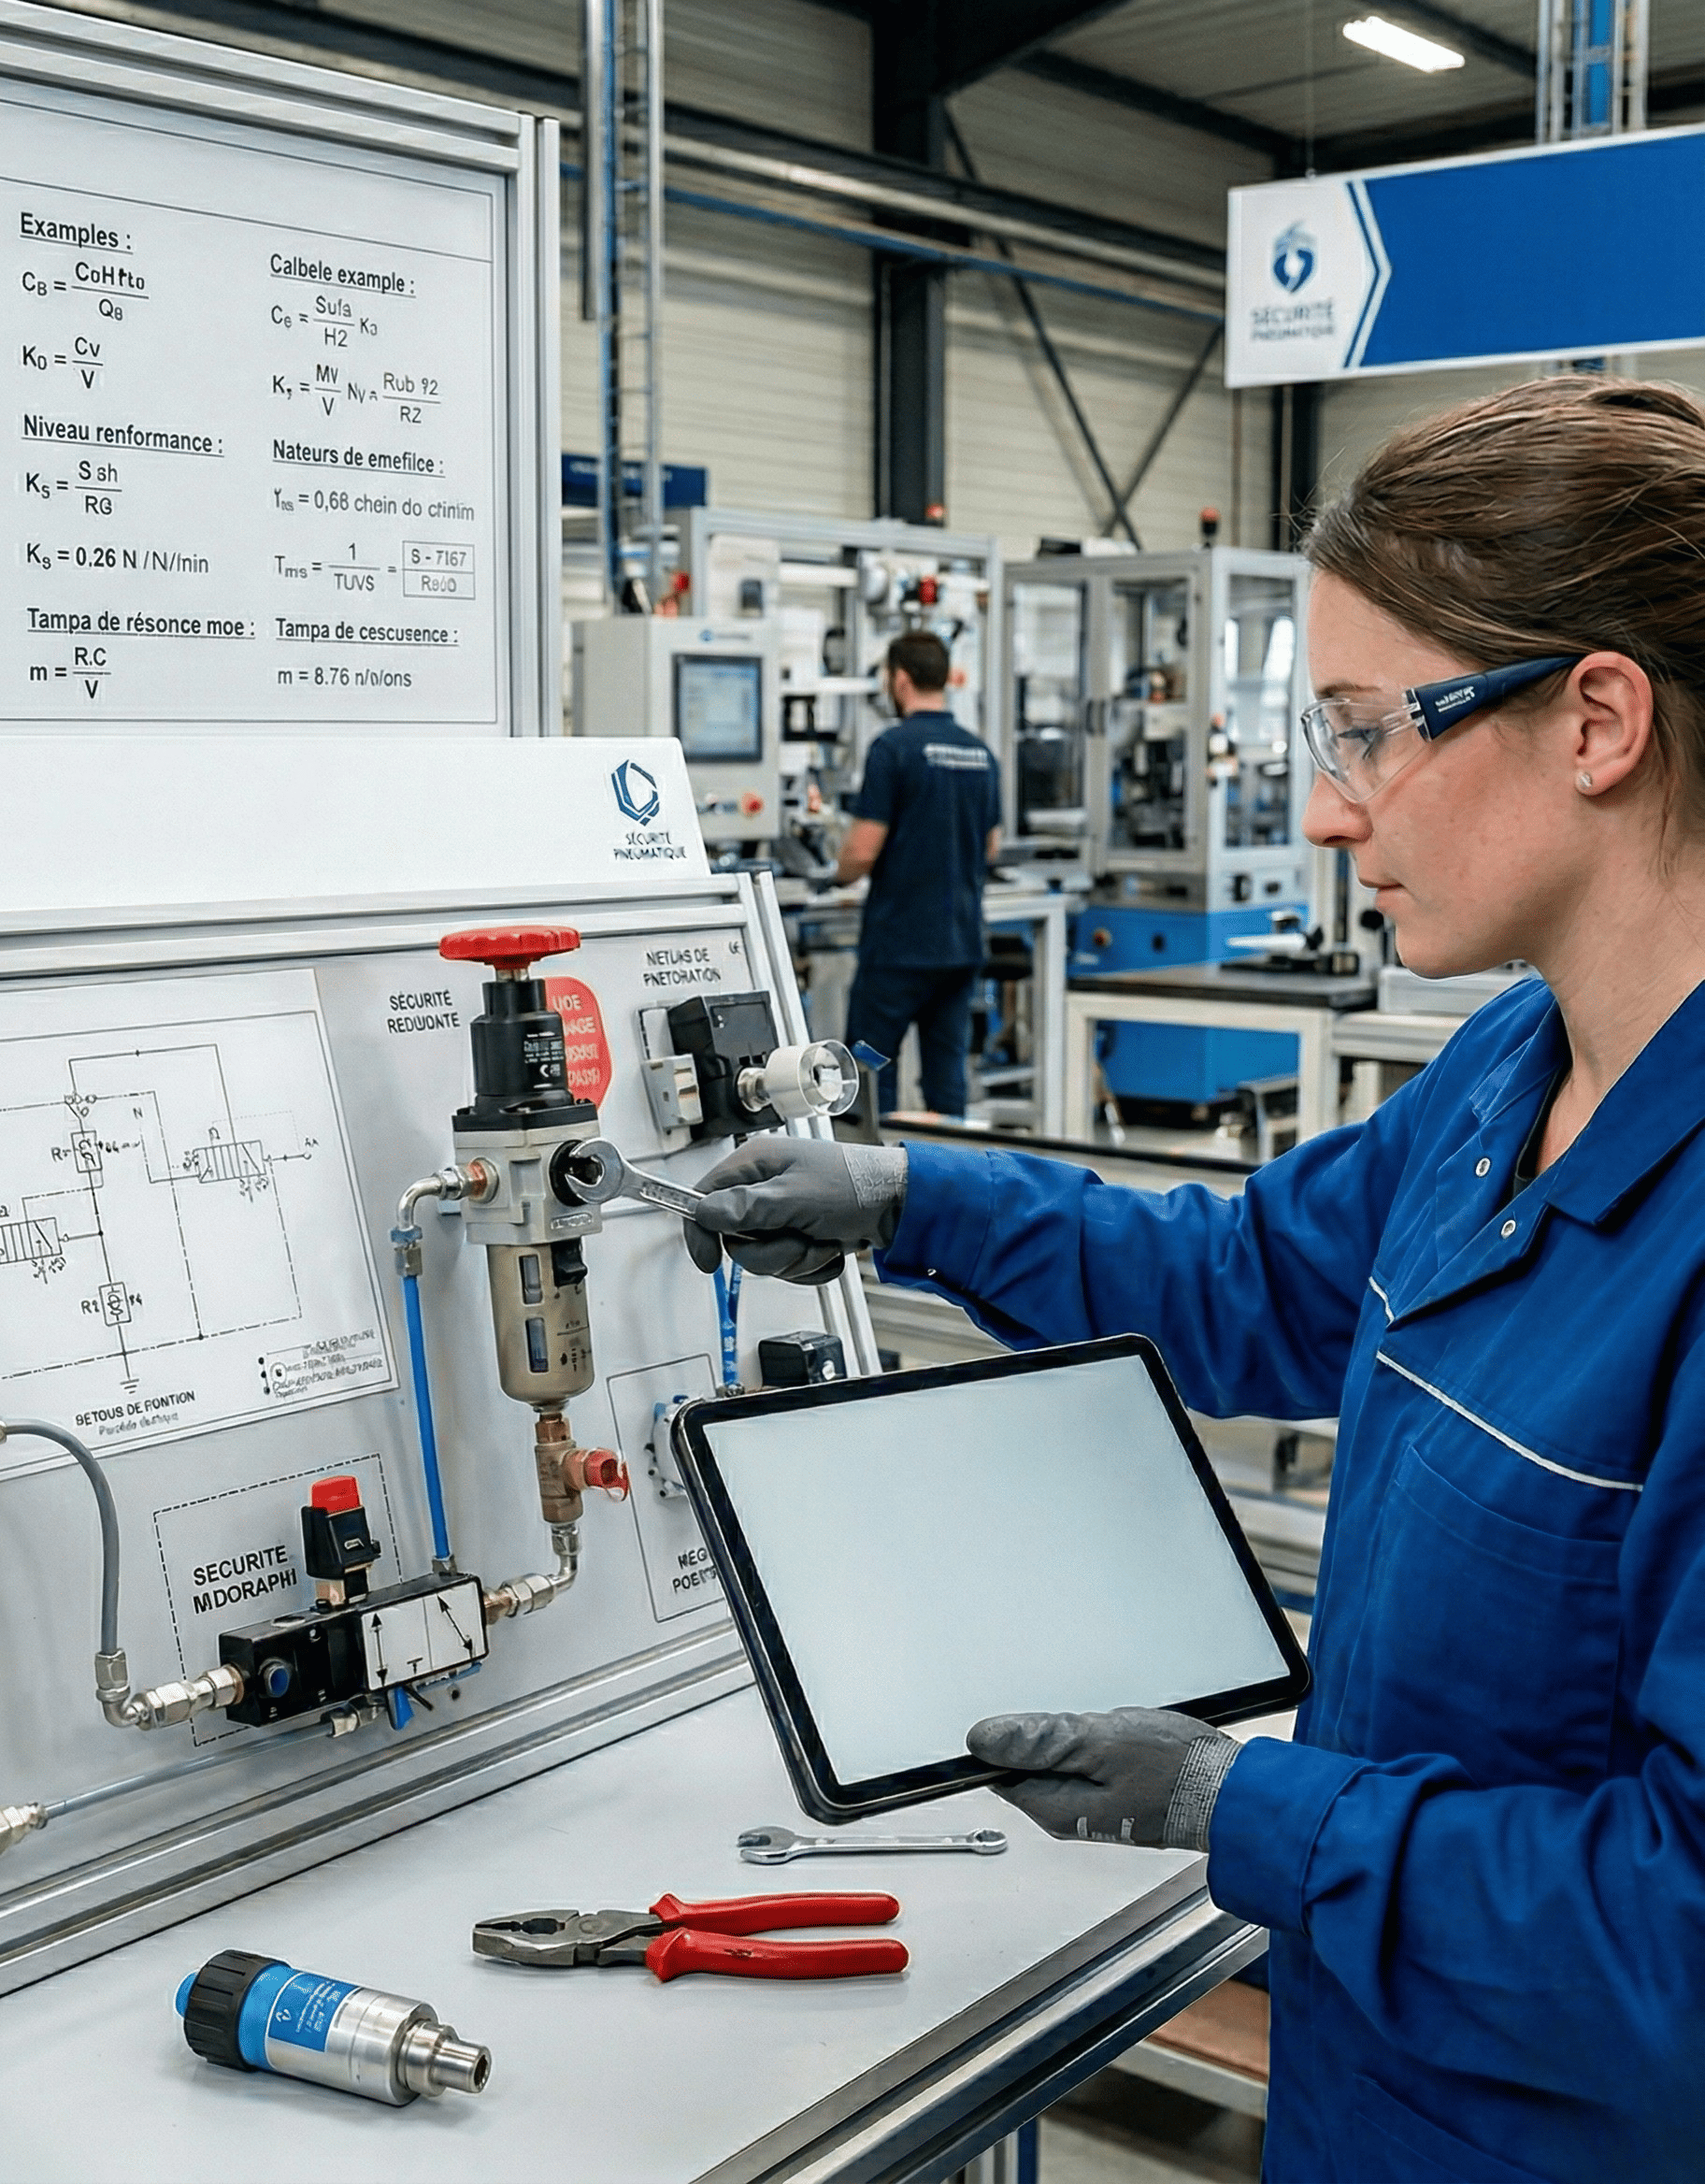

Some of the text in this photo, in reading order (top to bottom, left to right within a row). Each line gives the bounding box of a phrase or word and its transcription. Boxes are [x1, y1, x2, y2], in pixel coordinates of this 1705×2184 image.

[21, 211, 119, 248] Examples
[270, 253, 333, 281] Calbele
[337, 268, 406, 295] example
[81, 369, 95, 389] V
[322, 396, 335, 416] V
[24, 413, 90, 440] Niveau
[96, 424, 213, 453] renformance
[273, 438, 339, 464] Nateurs
[344, 446, 364, 466] de
[354, 494, 397, 515] chein
[402, 497, 423, 517] do
[75, 546, 117, 568] 0.26
[348, 542, 356, 561] 1
[27, 608, 92, 634] Tampa
[98, 611, 121, 631] de
[126, 611, 201, 634] résonce
[207, 619, 245, 636] moe
[276, 618, 330, 642] Tampa
[335, 622, 354, 639] de
[29, 666, 48, 681] m
[278, 670, 293, 684] m
[314, 667, 350, 686] 8.76
[84, 680, 99, 699] V
[127, 1403, 143, 1415] DE
[193, 1545, 288, 1586] SECURITE
